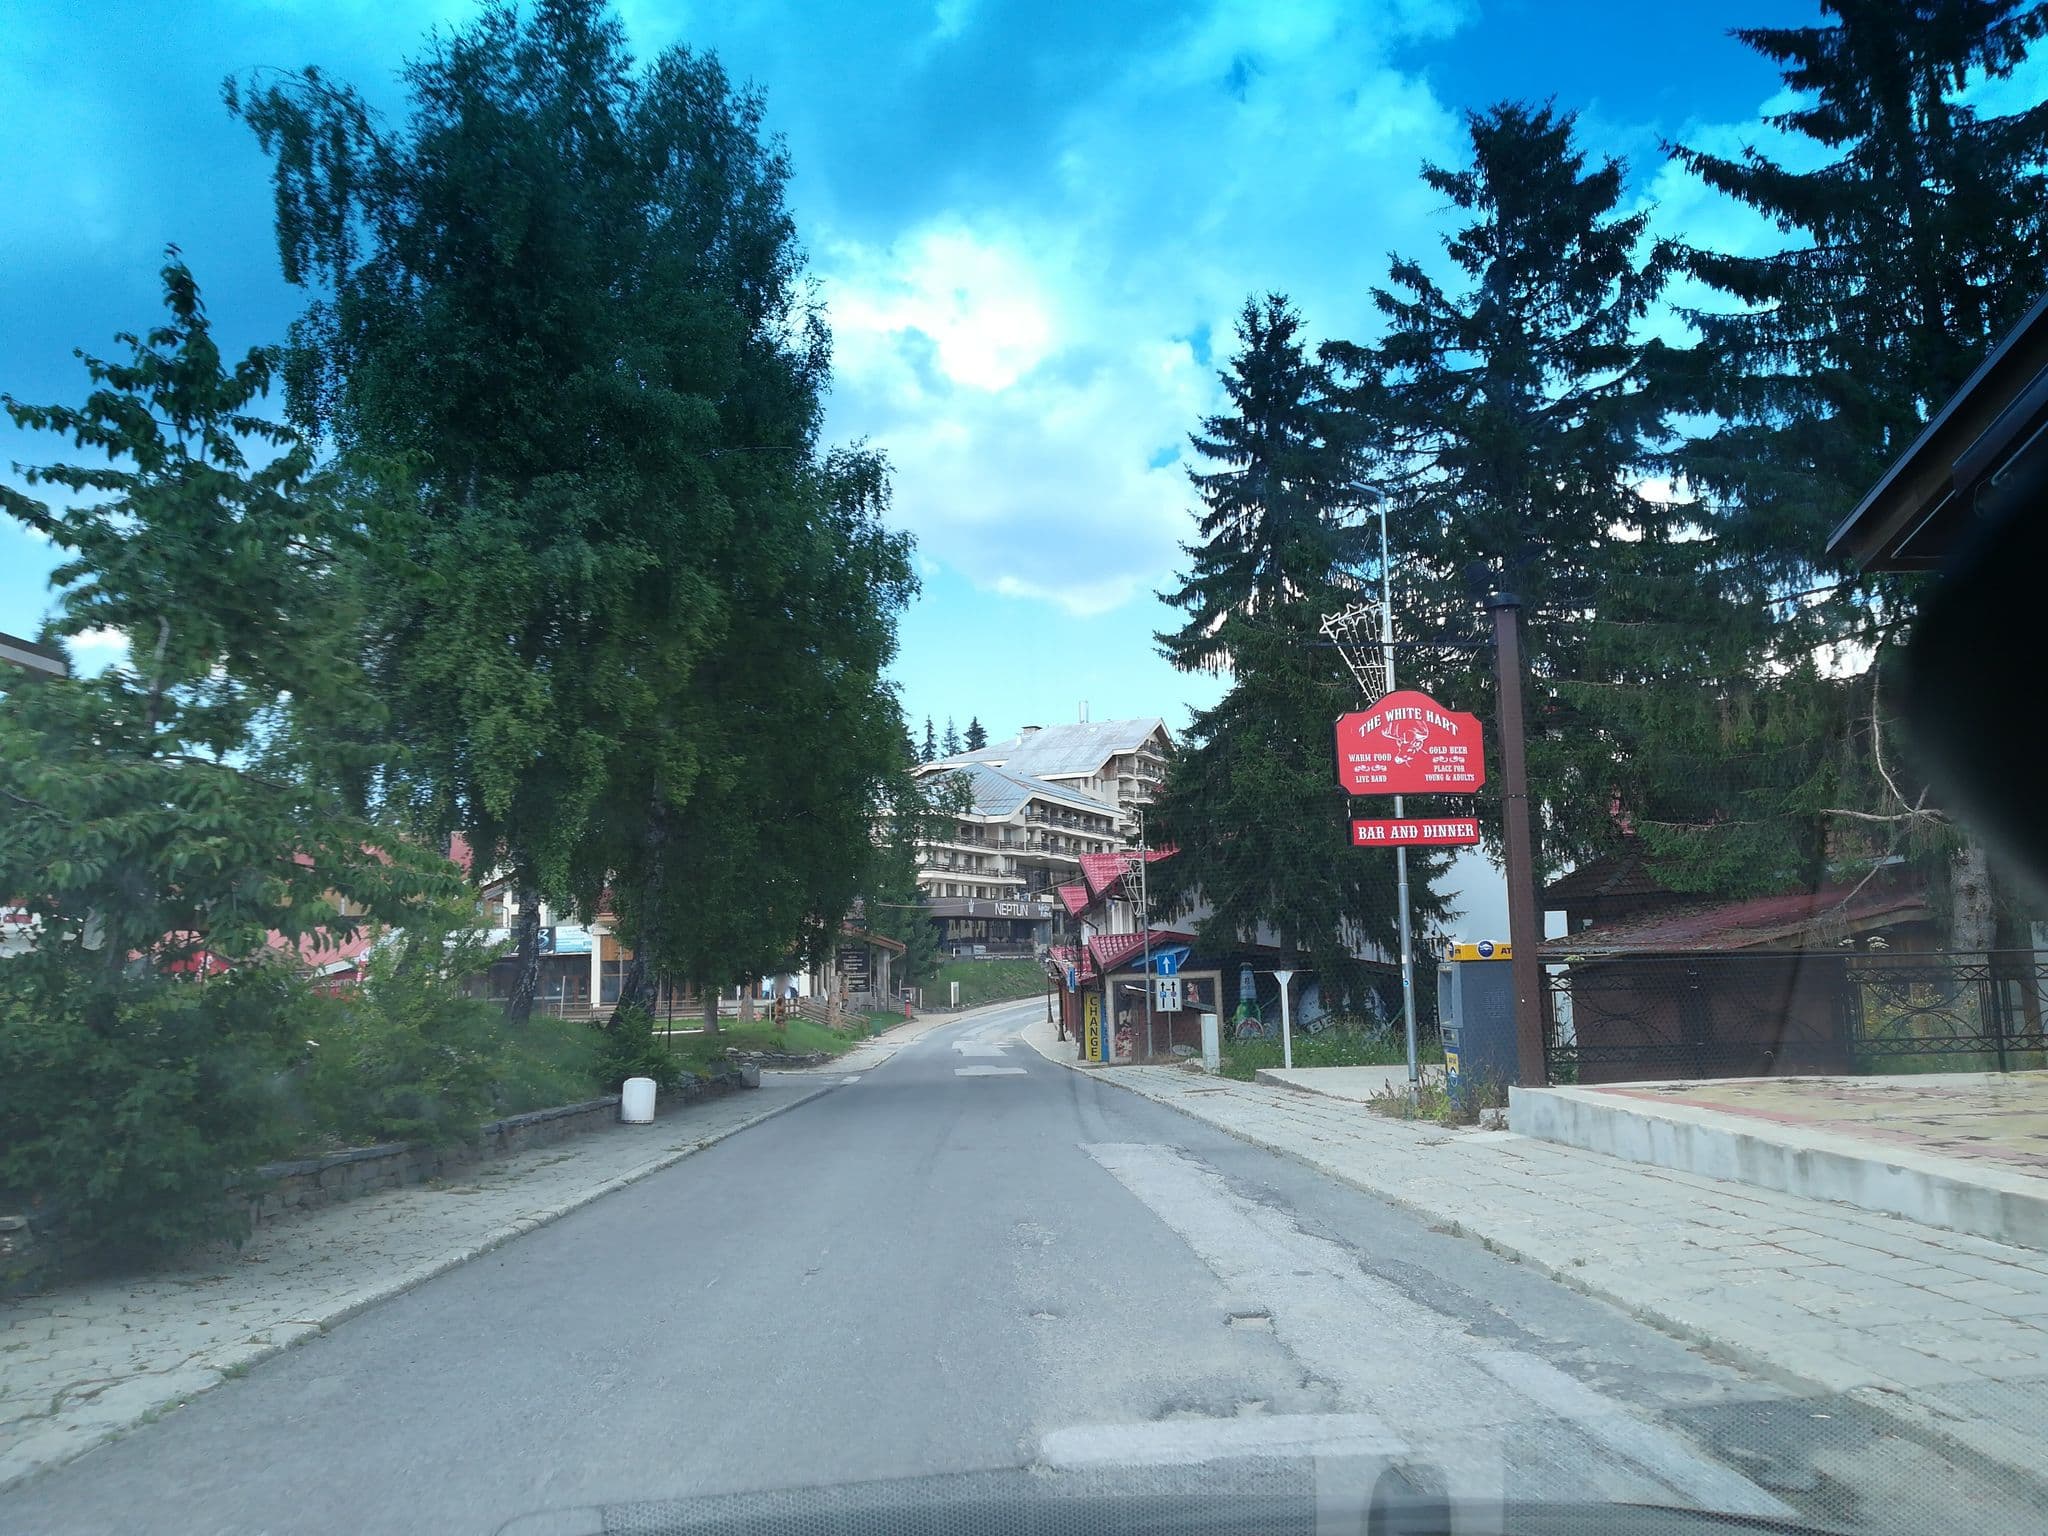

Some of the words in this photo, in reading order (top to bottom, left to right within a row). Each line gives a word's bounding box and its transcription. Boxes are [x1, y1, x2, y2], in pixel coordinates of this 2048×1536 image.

[1359, 714, 1382, 738] THE
[1385, 707, 1422, 722] WHITE
[1426, 710, 1458, 736] HART
[1449, 746, 1468, 755] BEER
[1349, 754, 1371, 762] WARM
[1374, 753, 1392, 761] FOOD
[1371, 775, 1387, 783] BAND
[1425, 774, 1443, 782] YOUNG
[1453, 774, 1475, 782] ADULTS
[1358, 826, 1386, 840] BAR
[1390, 825, 1418, 839] AND
[1422, 823, 1475, 838] DINNER
[994, 903, 1029, 916] NEPTUN
[1090, 997, 1098, 1057] CHANGE
